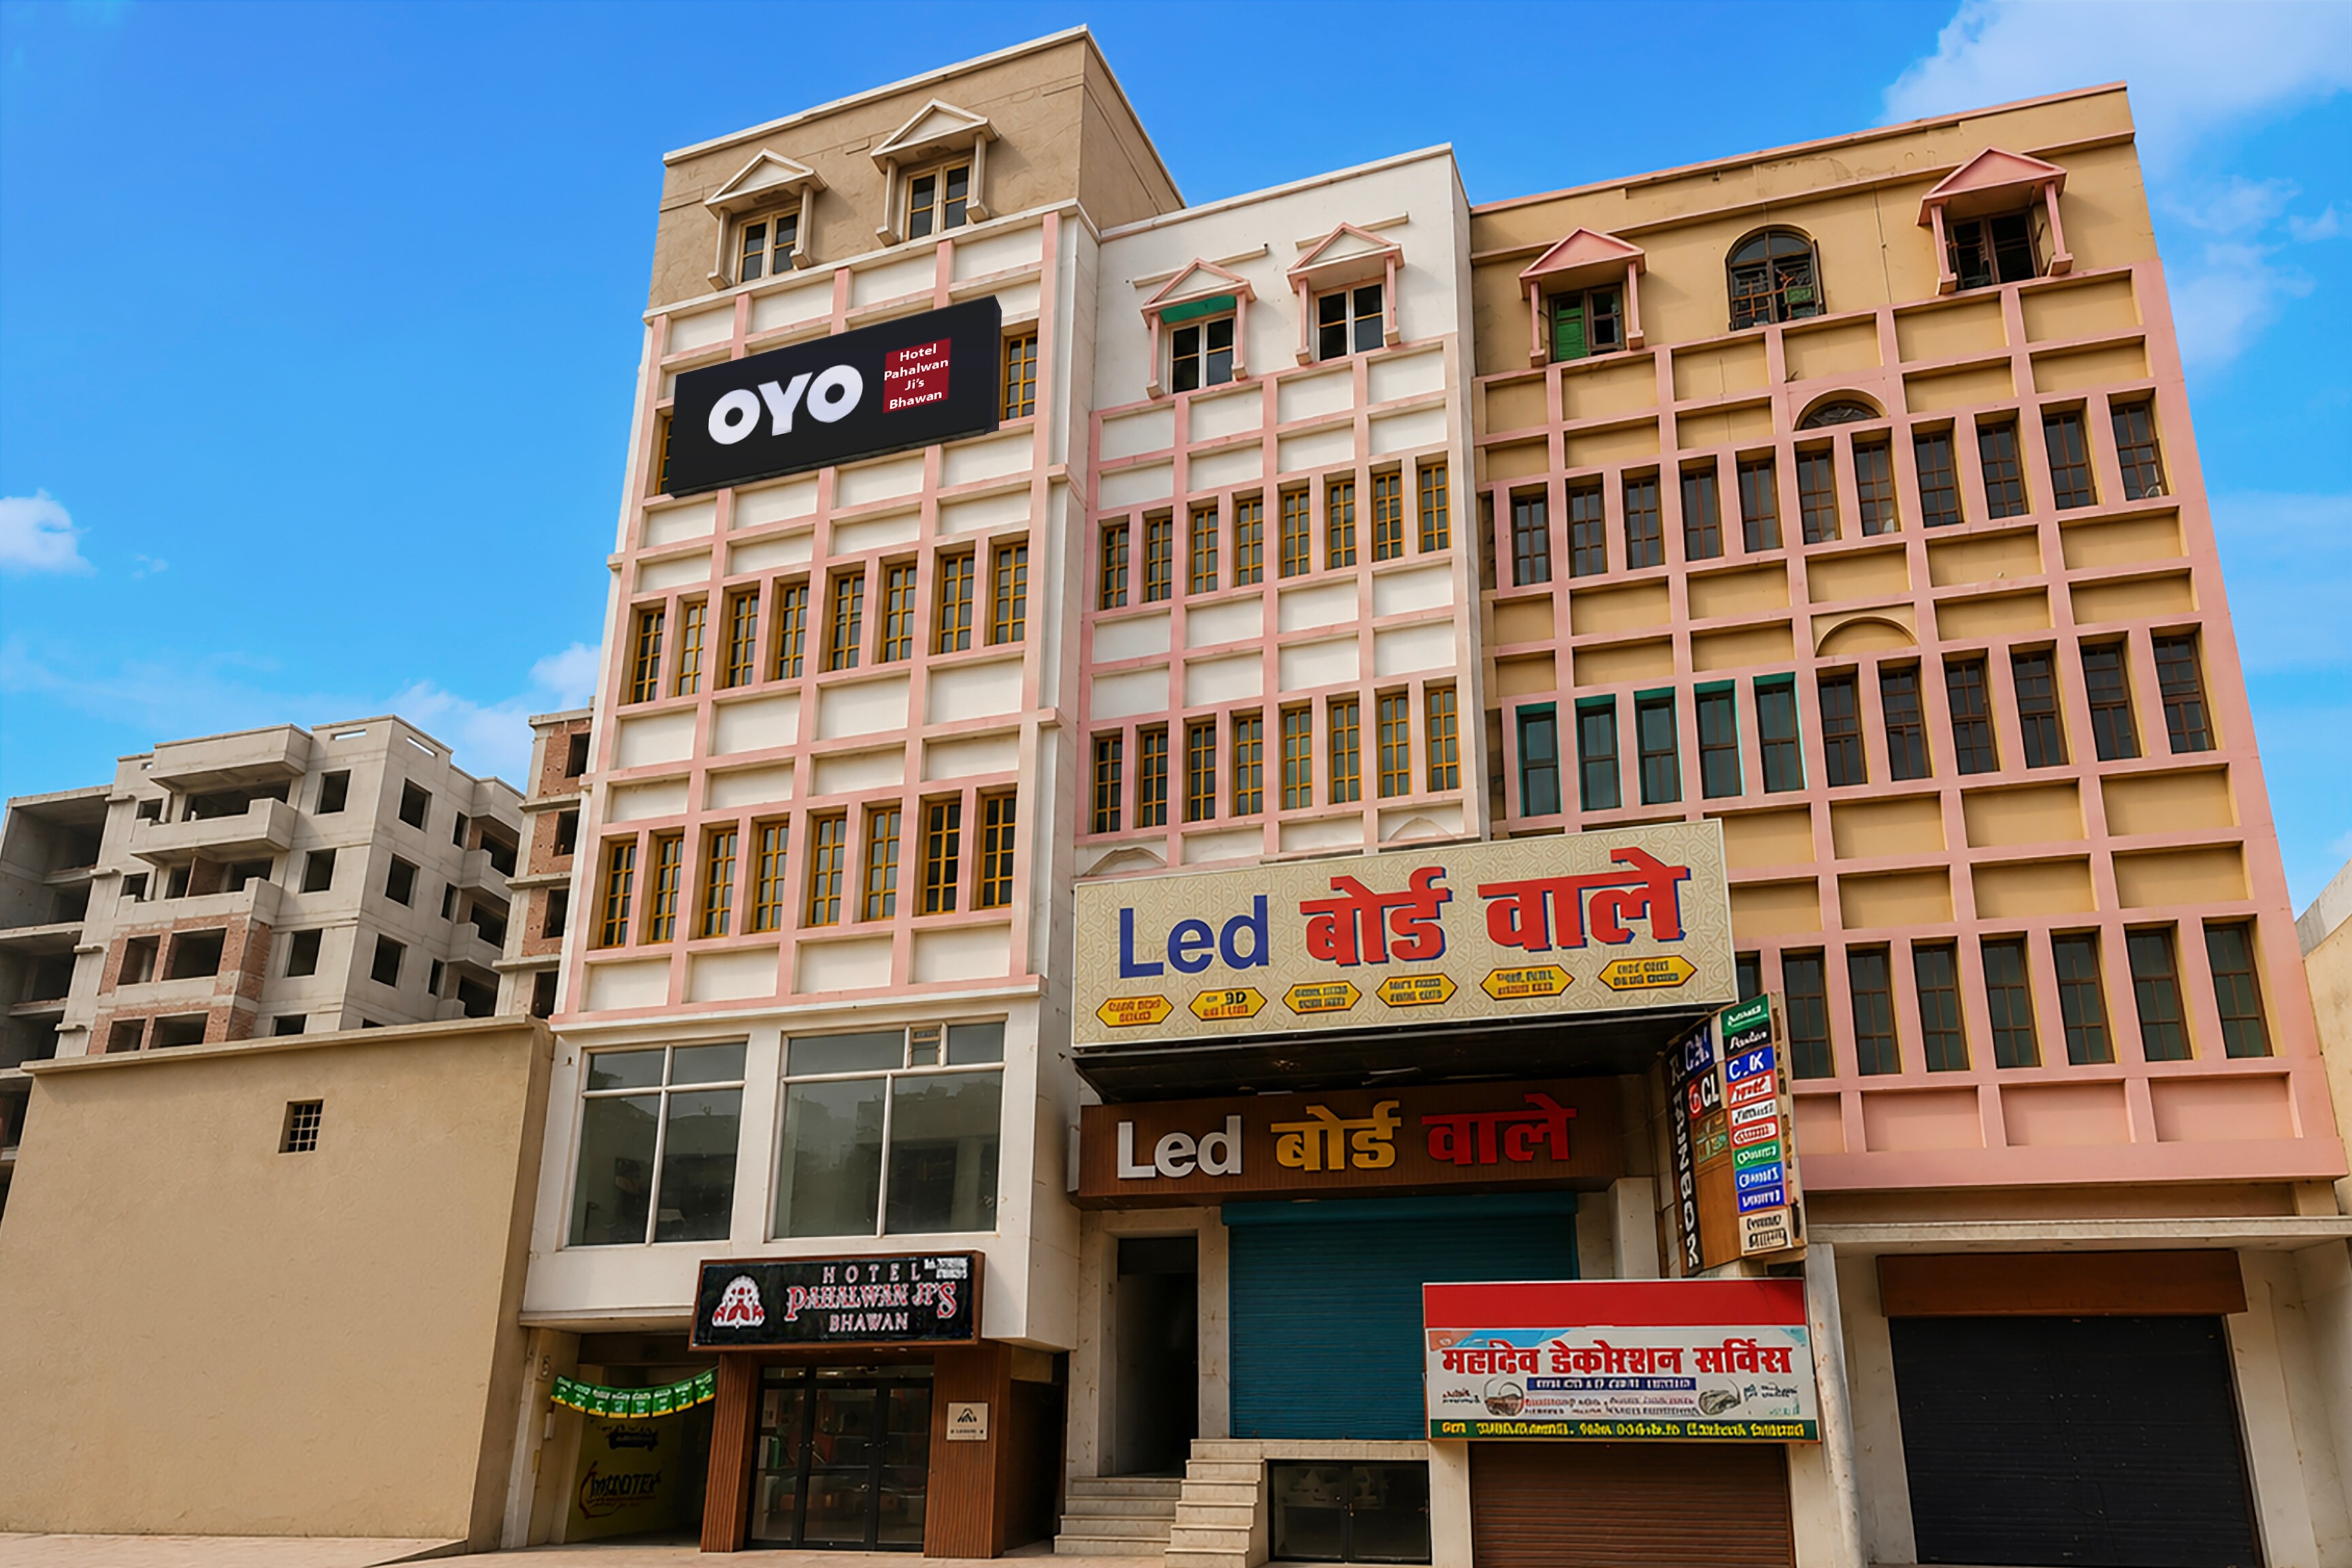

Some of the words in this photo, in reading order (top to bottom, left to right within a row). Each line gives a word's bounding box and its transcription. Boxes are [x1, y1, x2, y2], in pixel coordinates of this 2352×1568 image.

[900, 343, 936, 362] Hotel
[884, 359, 949, 381] Pahalwan
[904, 378, 924, 391] Ji's
[708, 364, 864, 445] OYO
[889, 391, 942, 410] Bhawan
[1119, 895, 1269, 979] Led
[1299, 866, 1452, 967] बोर्ड
[1477, 847, 1691, 951] वाले
[1117, 1114, 1242, 1179] Led
[1270, 1100, 1402, 1171] बोर्ड
[1421, 1092, 1578, 1165] वाले
[822, 1262, 921, 1284] HOTEL
[784, 1283, 909, 1322] PAHALWAN
[829, 1312, 909, 1333] BHAWAN
[1693, 1338, 1793, 1373] सर्विस
